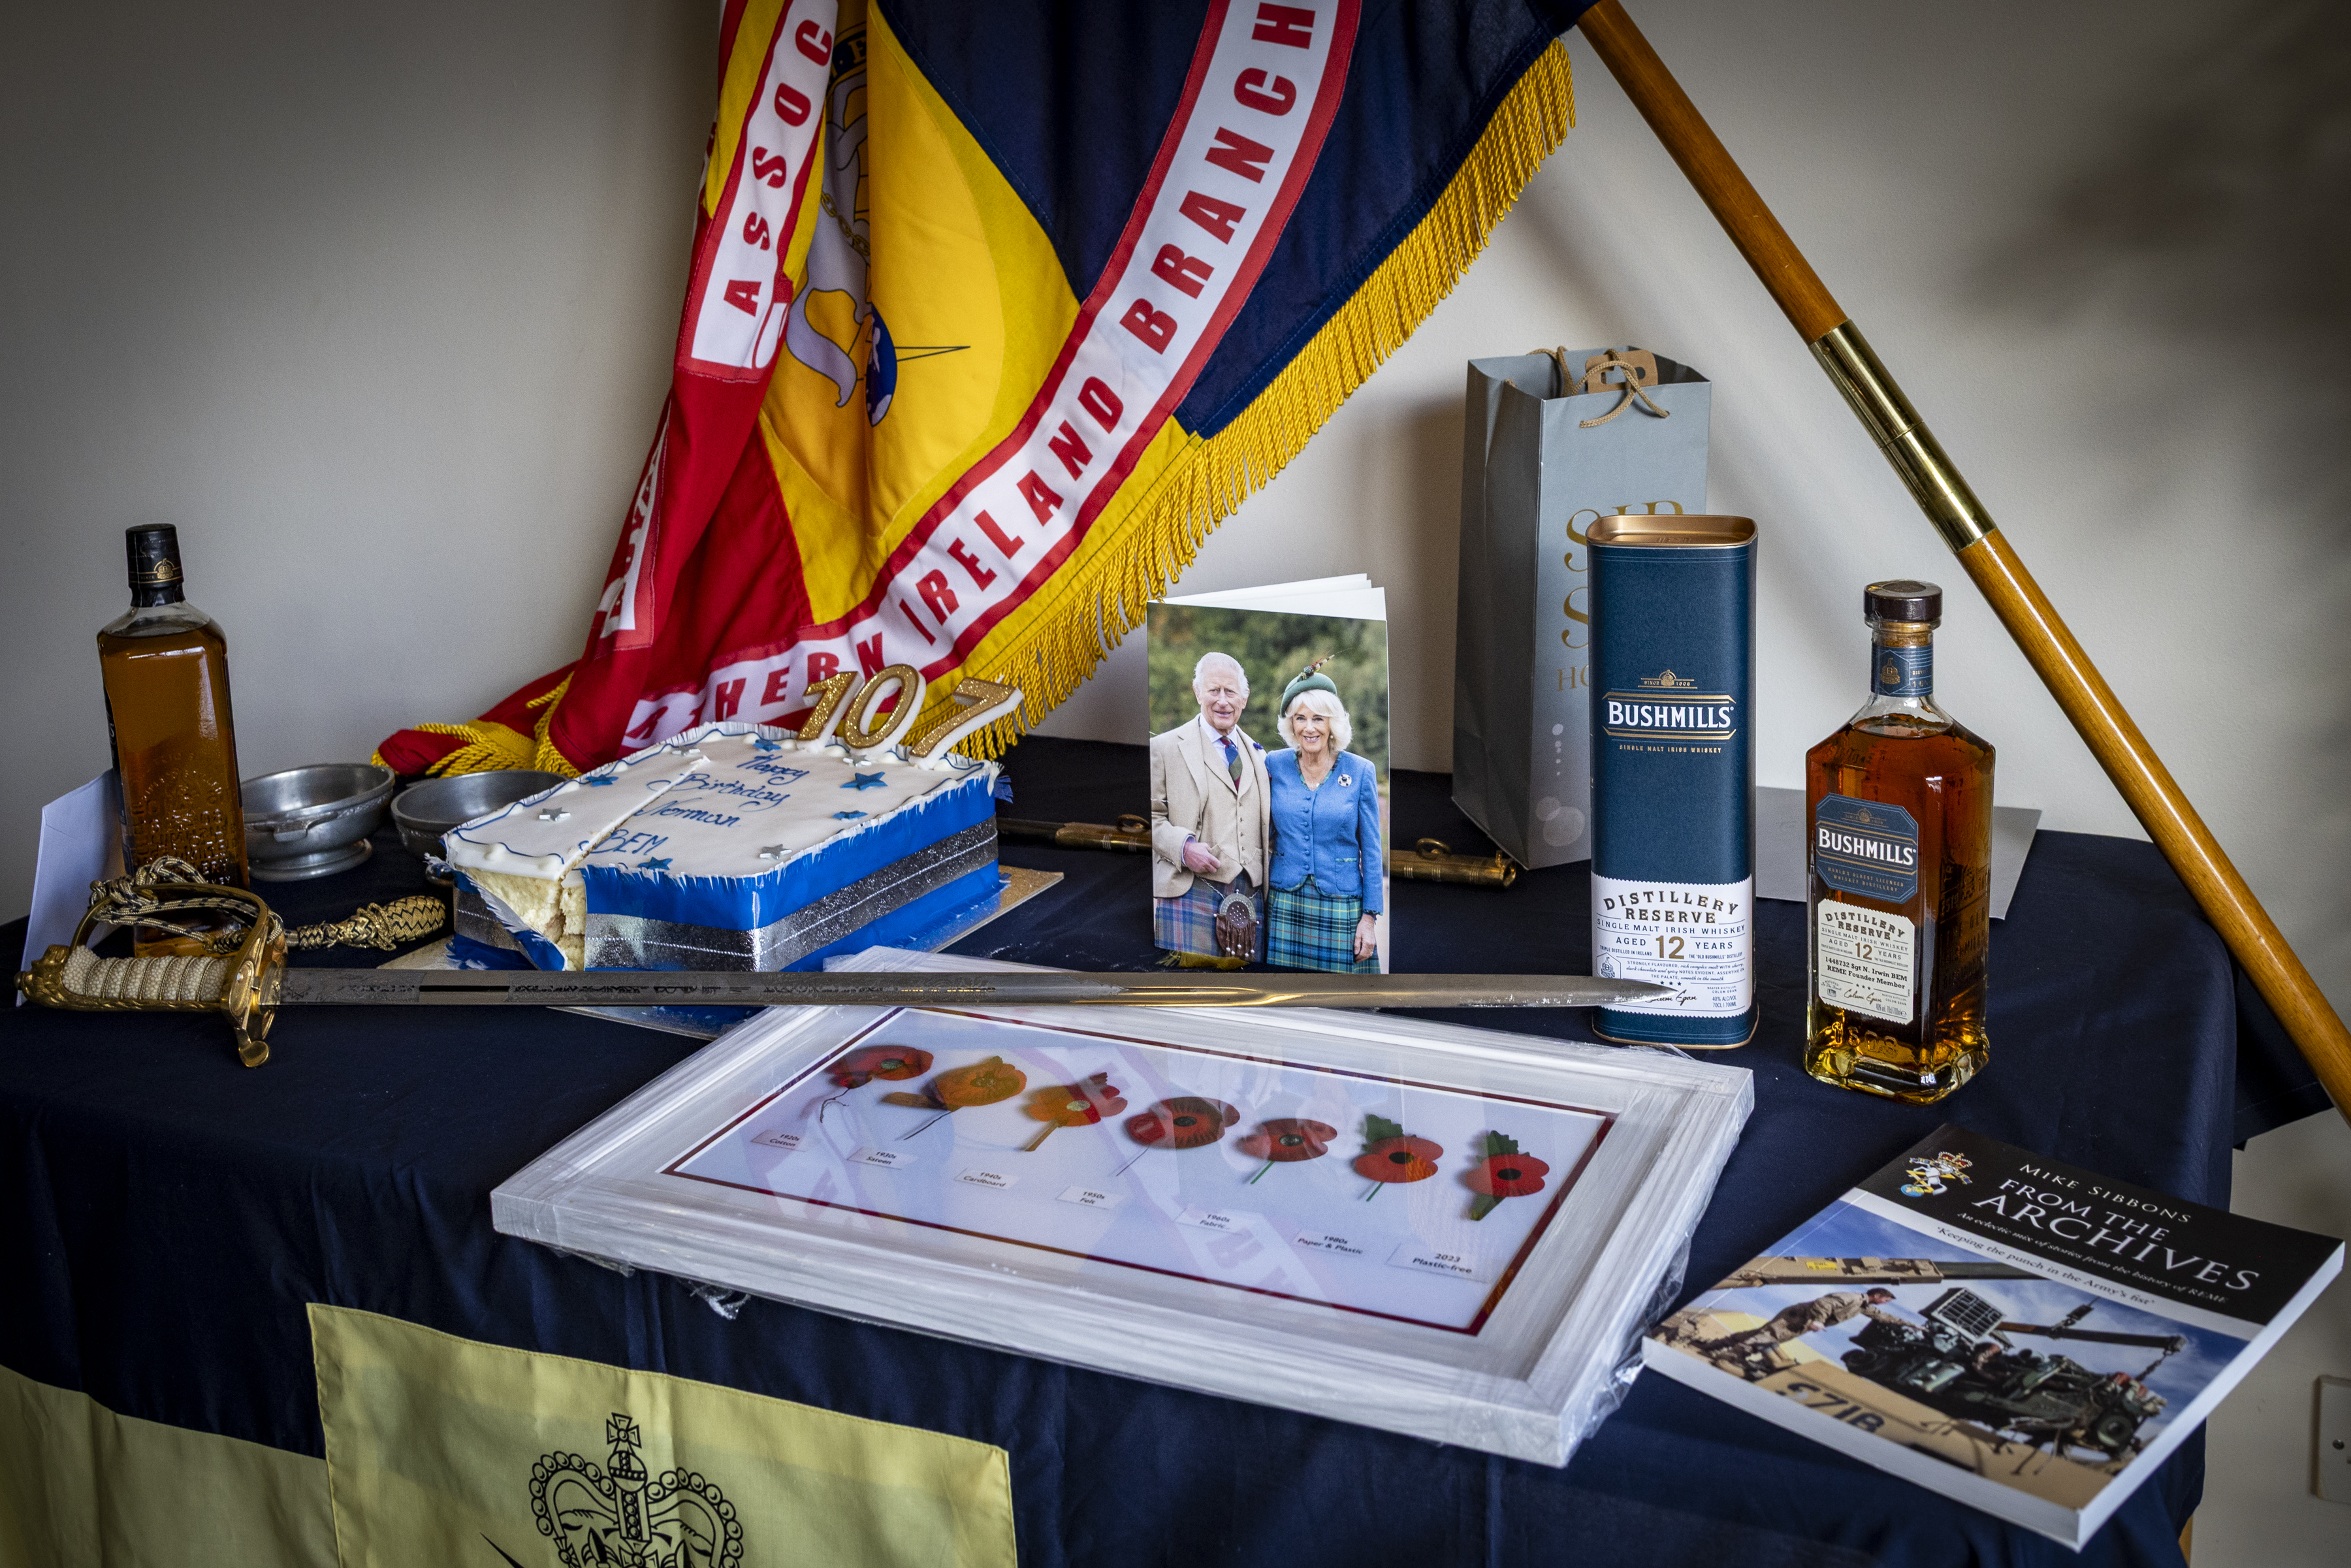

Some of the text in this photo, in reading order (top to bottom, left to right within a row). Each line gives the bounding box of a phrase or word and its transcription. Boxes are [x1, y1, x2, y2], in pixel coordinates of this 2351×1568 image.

[899, 376, 1125, 647] IRELAND
[1119, 0, 1315, 355] BRANCH
[795, 663, 1023, 770] 107
[1608, 701, 1731, 728] BUSHMILLS
[736, 754, 810, 786] Happy
[646, 773, 791, 812] Birthday
[633, 797, 741, 827] Norman
[1819, 828, 1913, 866] BUSHMILLS
[1603, 890, 1738, 916] DISTILLERY
[1597, 918, 1629, 930] SINGLE
[1701, 924, 1745, 935] WHISKEY
[1625, 908, 1716, 924] RESERVE
[1825, 912, 1906, 938] DISTILLERY
[1821, 927, 1842, 936] SINGLE
[1861, 936, 1878, 945] IRISH
[1879, 941, 1908, 952] WHISKEY
[1838, 921, 1891, 940] RESERVE
[1616, 936, 1646, 946] AGED
[1655, 935, 1685, 959] 12
[1829, 938, 1902, 961] AGED 12 YEARS
[1825, 956, 1849, 967] 1448732
[1872, 968, 1889, 978] Irwin
[1891, 972, 1908, 982] BEM
[1827, 965, 1906, 989] REME Founder Member
[769, 1138, 796, 1147] Cotton
[866, 1156, 892, 1165] Sateen
[876, 1151, 897, 1159] 1930s
[963, 1175, 1006, 1188] Cardboard
[980, 1172, 1002, 1180] 1940s
[1082, 1191, 1106, 1200] 1950s
[2019, 1164, 2192, 1223] MIKE SIBBONS
[1207, 1213, 1230, 1223] 1960s
[1998, 1178, 2170, 1241] FROM THE
[1297, 1238, 1324, 1247] Paper
[1334, 1244, 1364, 1255] Plastic
[1324, 1235, 1349, 1245] 1980s
[1970, 1194, 2260, 1291] ARCHIVES
[1413, 1257, 1472, 1273] Plastic-free
[1434, 1253, 1461, 1262] 2023
[1957, 1213, 1974, 1221] An
[1974, 1219, 2011, 1235] eclectic
[2012, 1231, 2034, 1243] mix
[2034, 1240, 2049, 1248] of
[2047, 1244, 2083, 1260] stories
[2082, 1255, 2111, 1268] from
[2112, 1265, 2131, 1274] the
[2132, 1271, 2171, 1288] history
[2188, 1288, 2230, 1304] REME
[1986, 1245, 2006, 1256] the
[2006, 1253, 2044, 1270] punch
[2047, 1266, 2059, 1275] in
[2062, 1271, 2082, 1283] the
[2083, 1279, 2128, 1298] Army's
